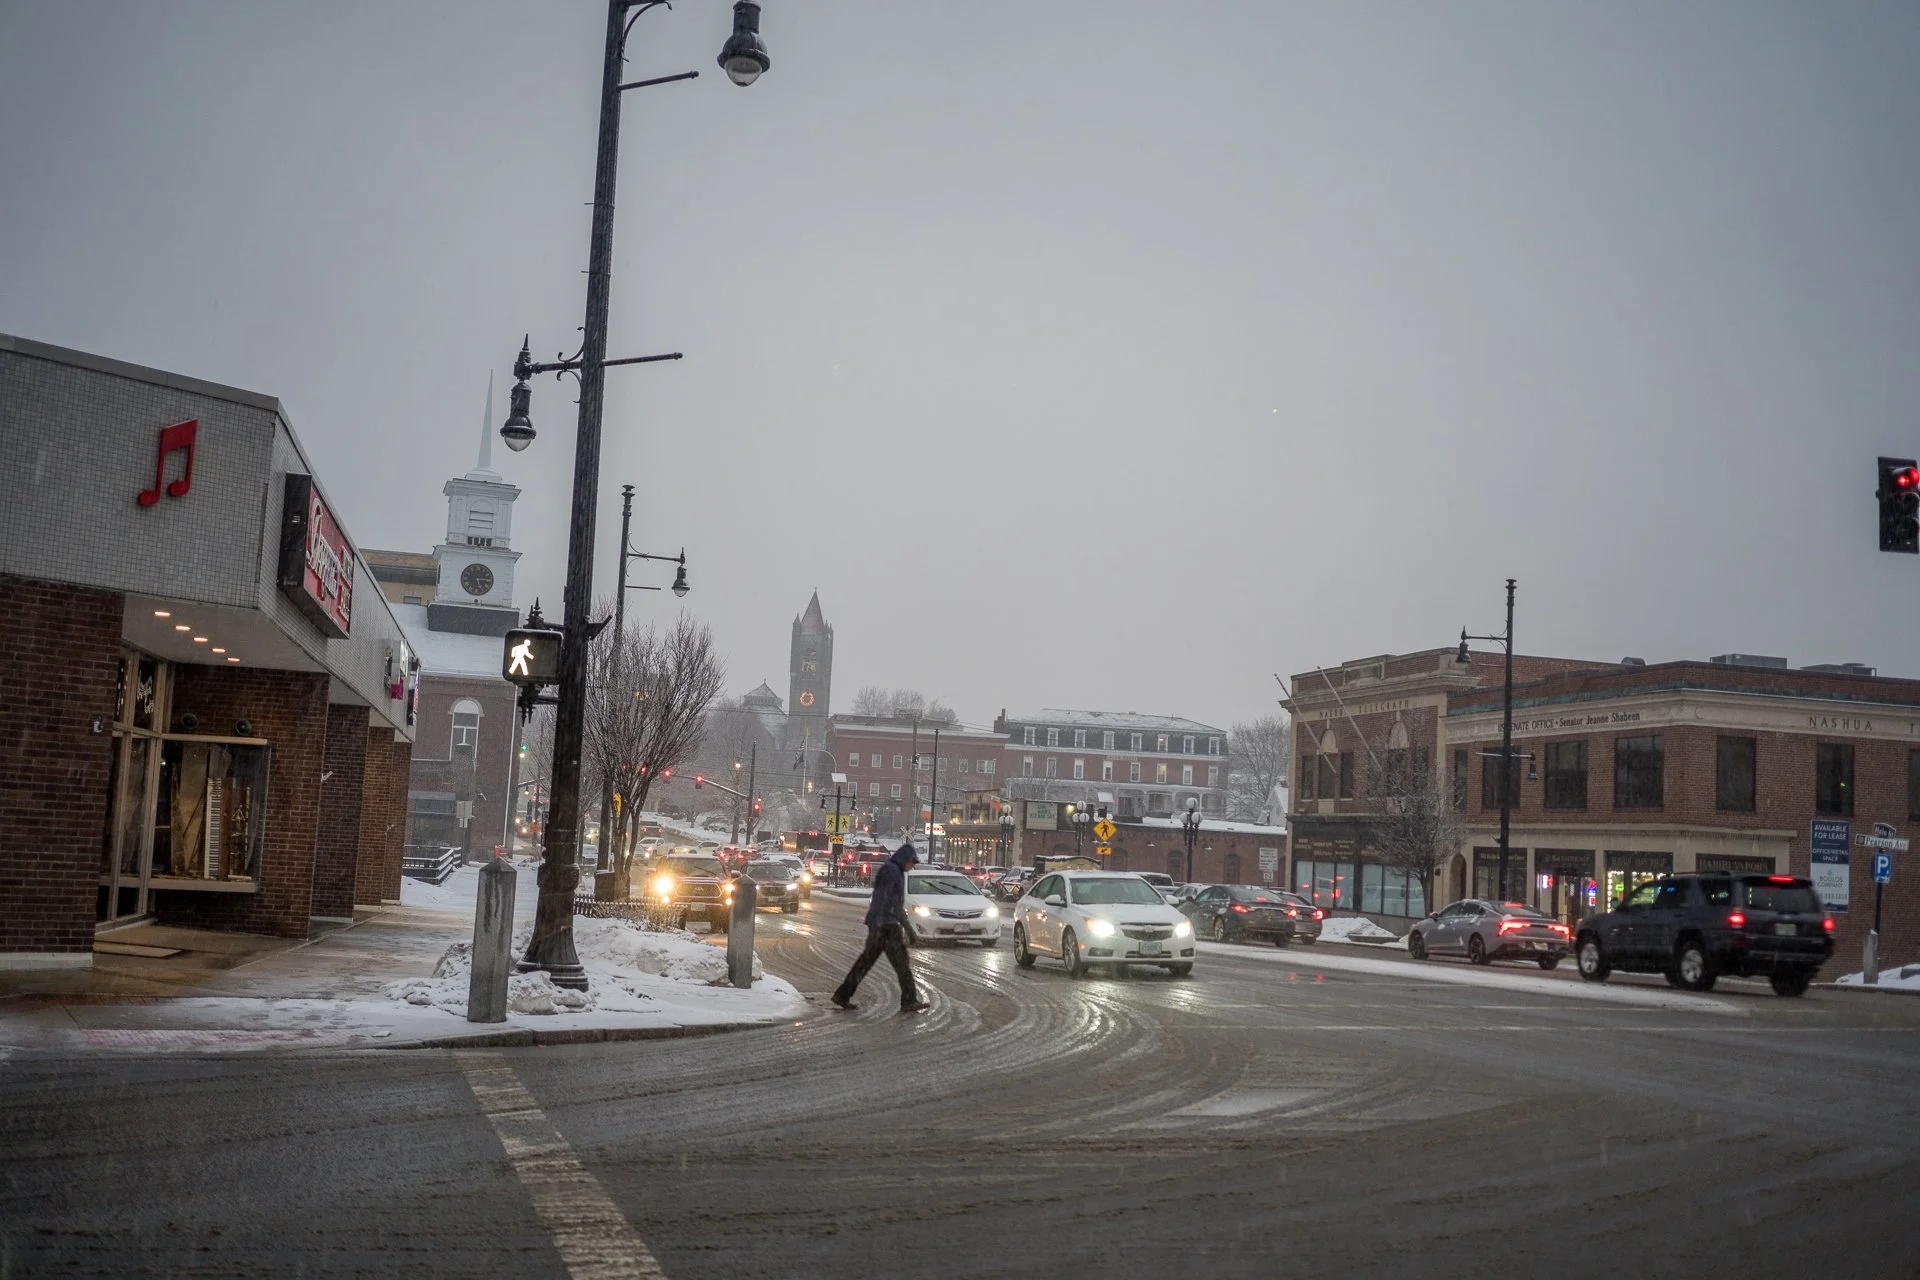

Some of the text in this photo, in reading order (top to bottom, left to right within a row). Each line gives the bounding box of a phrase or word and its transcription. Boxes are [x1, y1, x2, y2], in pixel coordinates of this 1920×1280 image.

[1532, 717, 1554, 730] OFFICE
[1559, 716, 1583, 727] Senator
[1586, 714, 1609, 725] Jeanne
[1809, 716, 1873, 731] NASHUA
[1814, 824, 1847, 833] AVAILABLE
[1814, 831, 1847, 841] FOR LEASE
[1866, 835, 1893, 848] Pearson
[1822, 855, 1839, 863] SPACE
[1877, 856, 1889, 874] P
